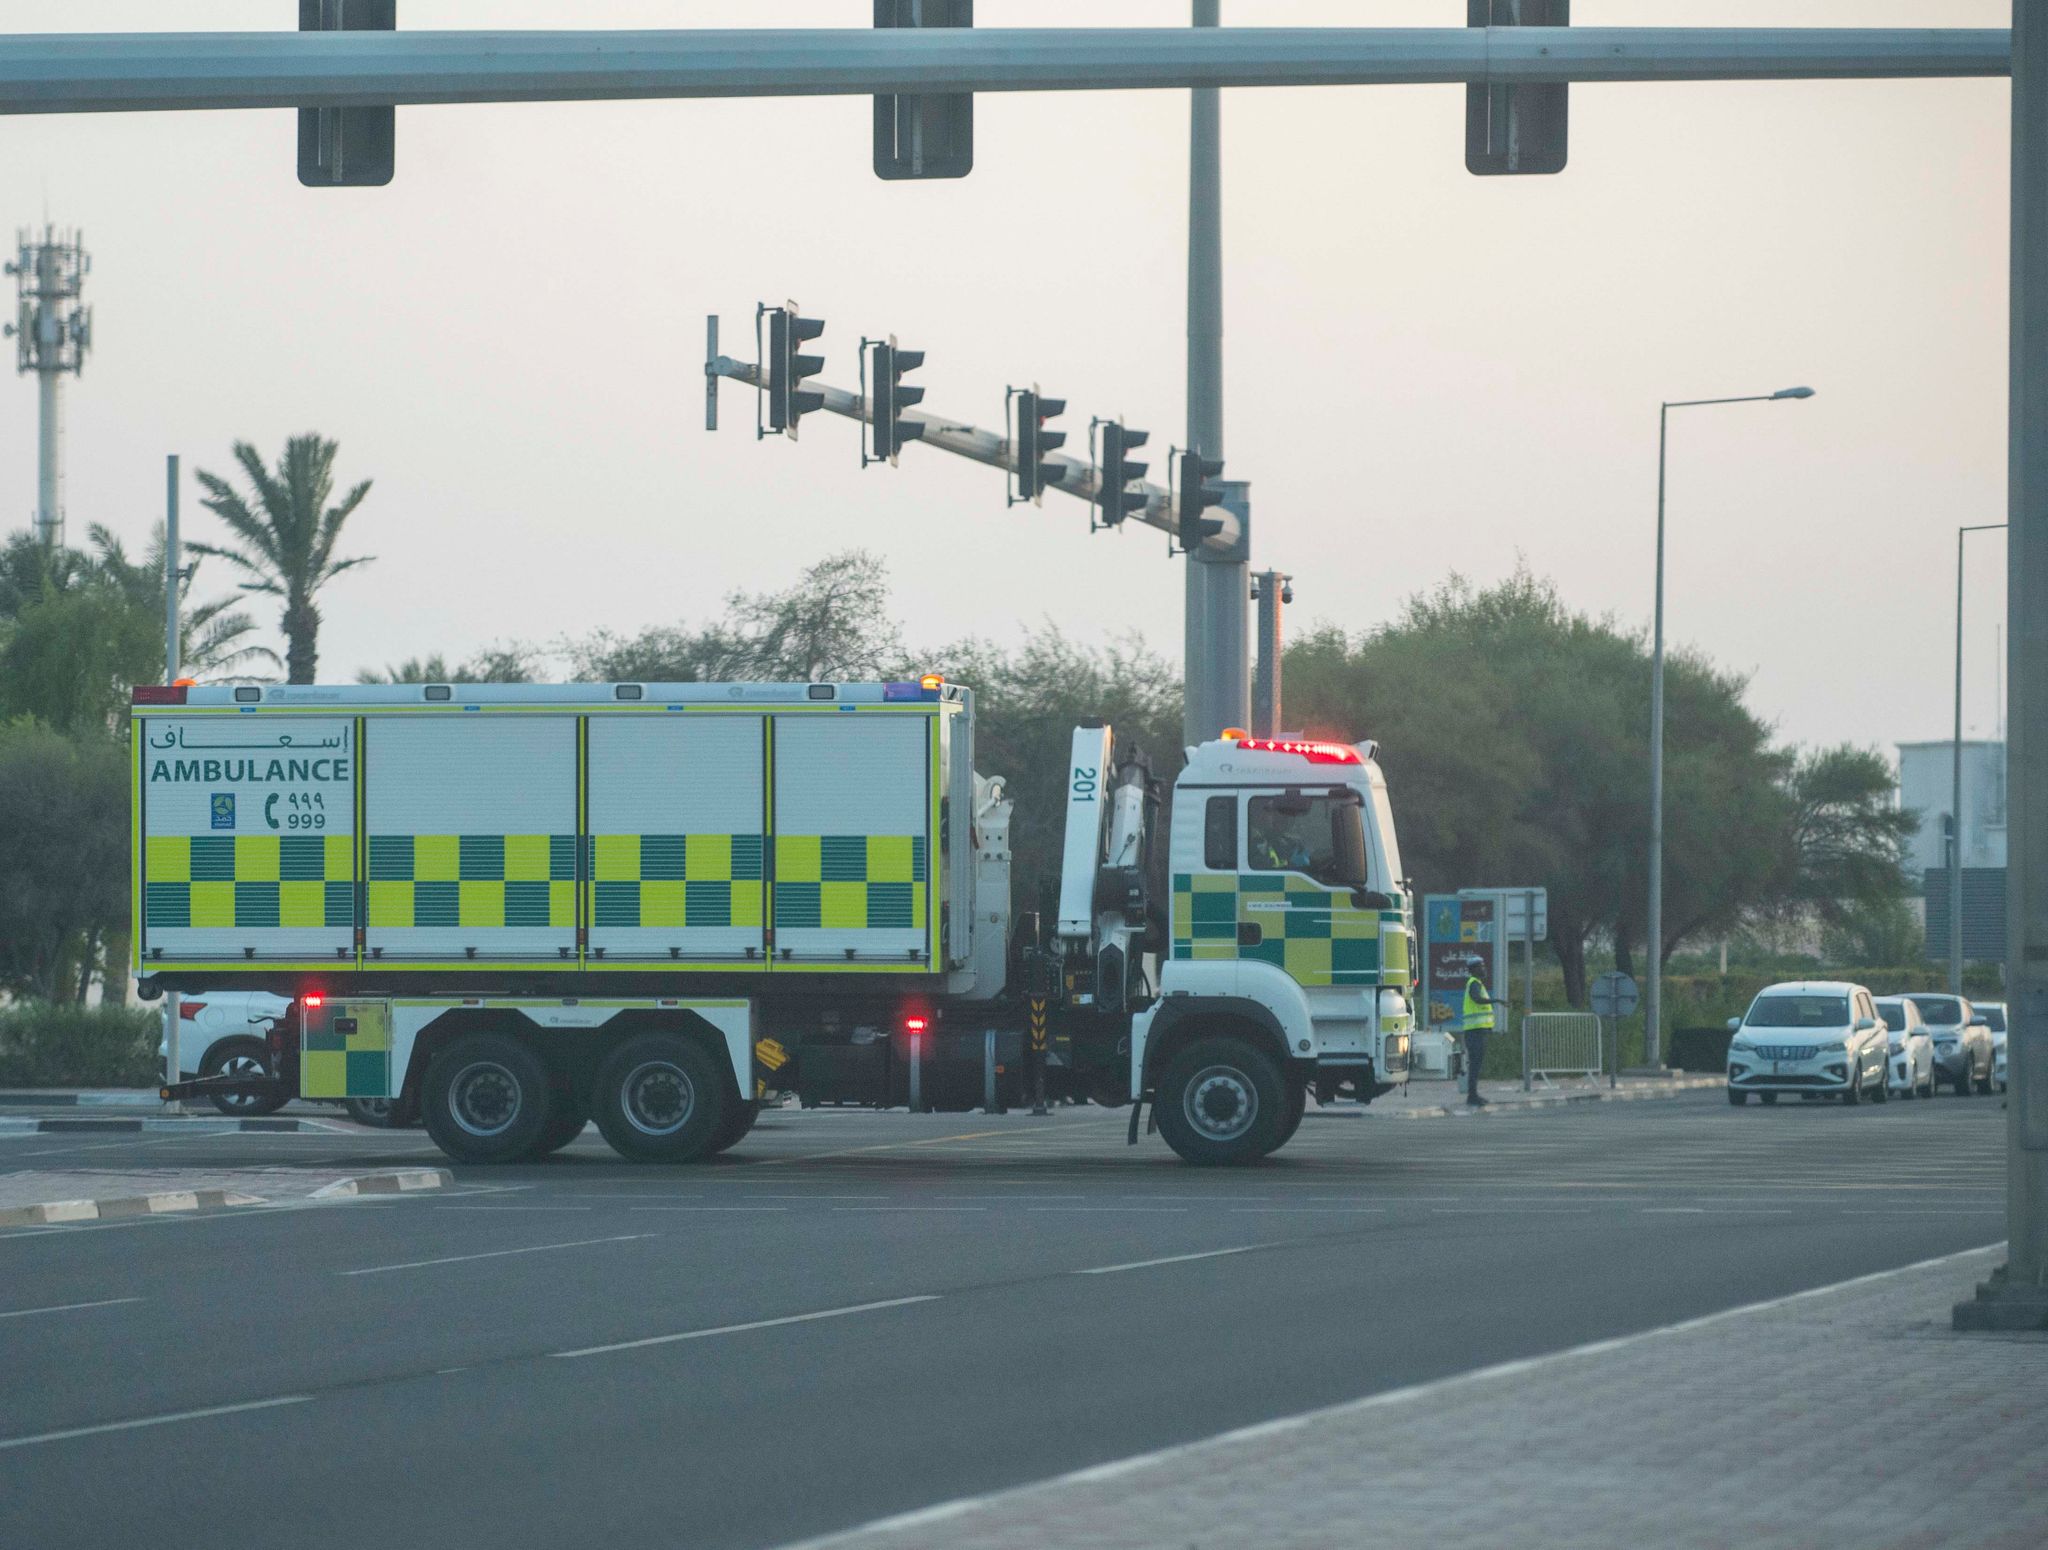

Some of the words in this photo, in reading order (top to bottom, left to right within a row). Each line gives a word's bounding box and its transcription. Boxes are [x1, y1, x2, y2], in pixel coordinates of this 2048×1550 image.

[150, 724, 348, 753] إسعاف
[151, 759, 349, 782] AMBULANCE
[1072, 767, 1097, 802] 201
[288, 792, 325, 810] ٩٩٩
[287, 813, 326, 829] 999
